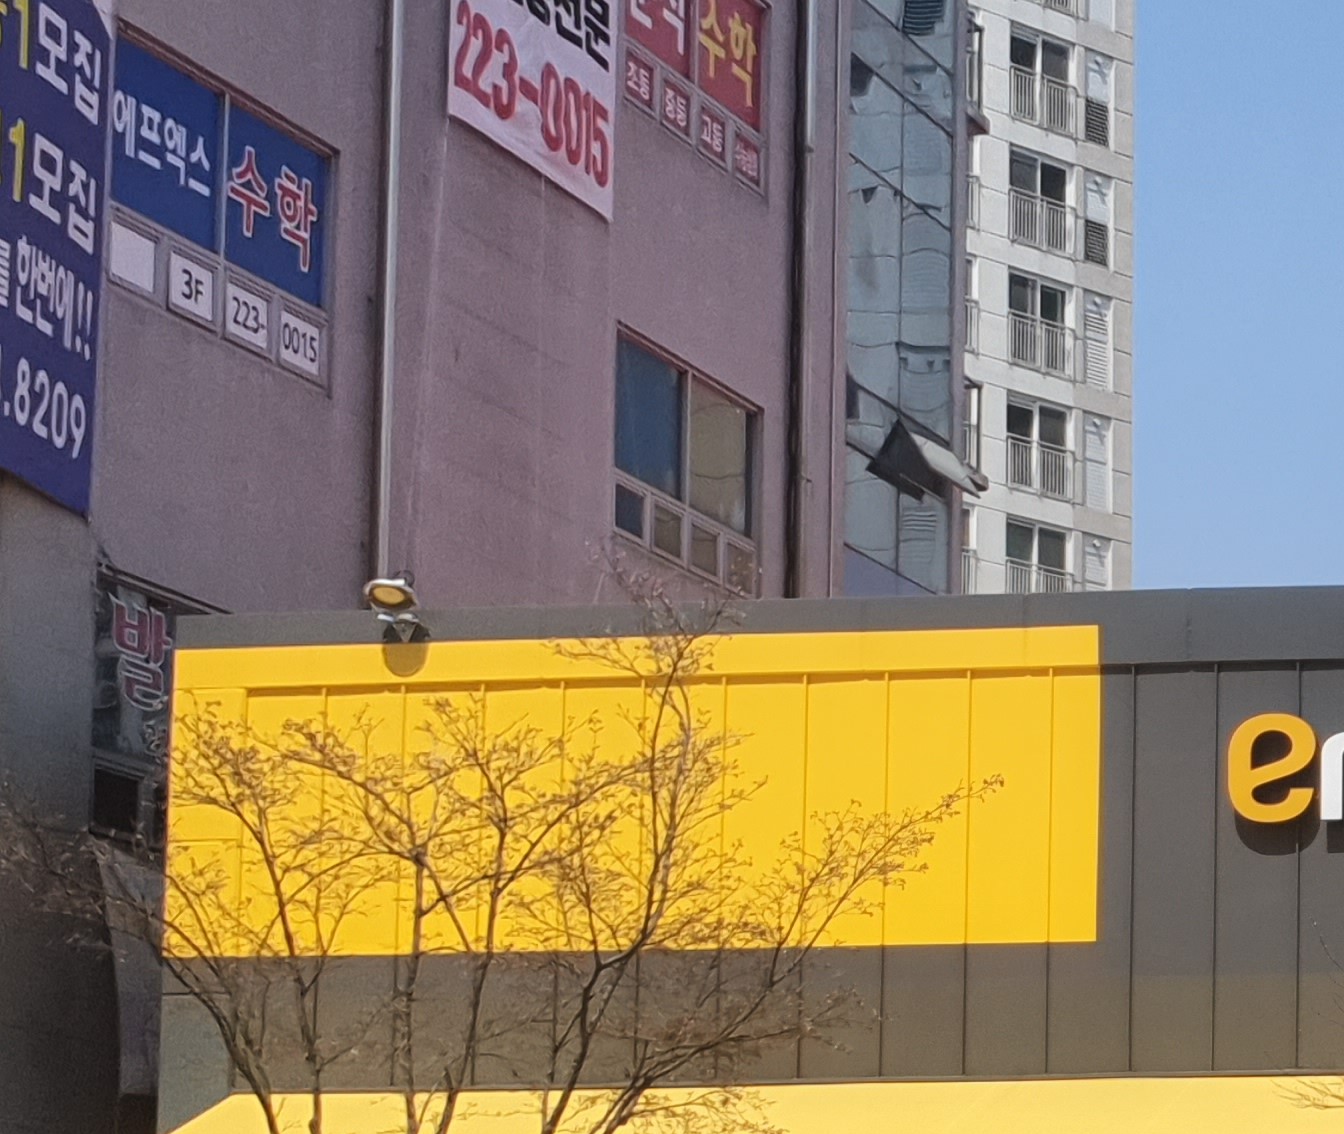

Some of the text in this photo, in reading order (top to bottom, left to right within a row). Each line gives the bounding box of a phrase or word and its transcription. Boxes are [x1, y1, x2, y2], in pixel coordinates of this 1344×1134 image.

[453, 0, 610, 188] 223-0015
[626, 60, 724, 153] 초등 중등 고등
[697, 0, 758, 108] 수학
[113, 89, 318, 273] 에프엑스 수학
[16, 233, 94, 362] 한번에!!
[180, 268, 319, 374] 3F 223- 0015
